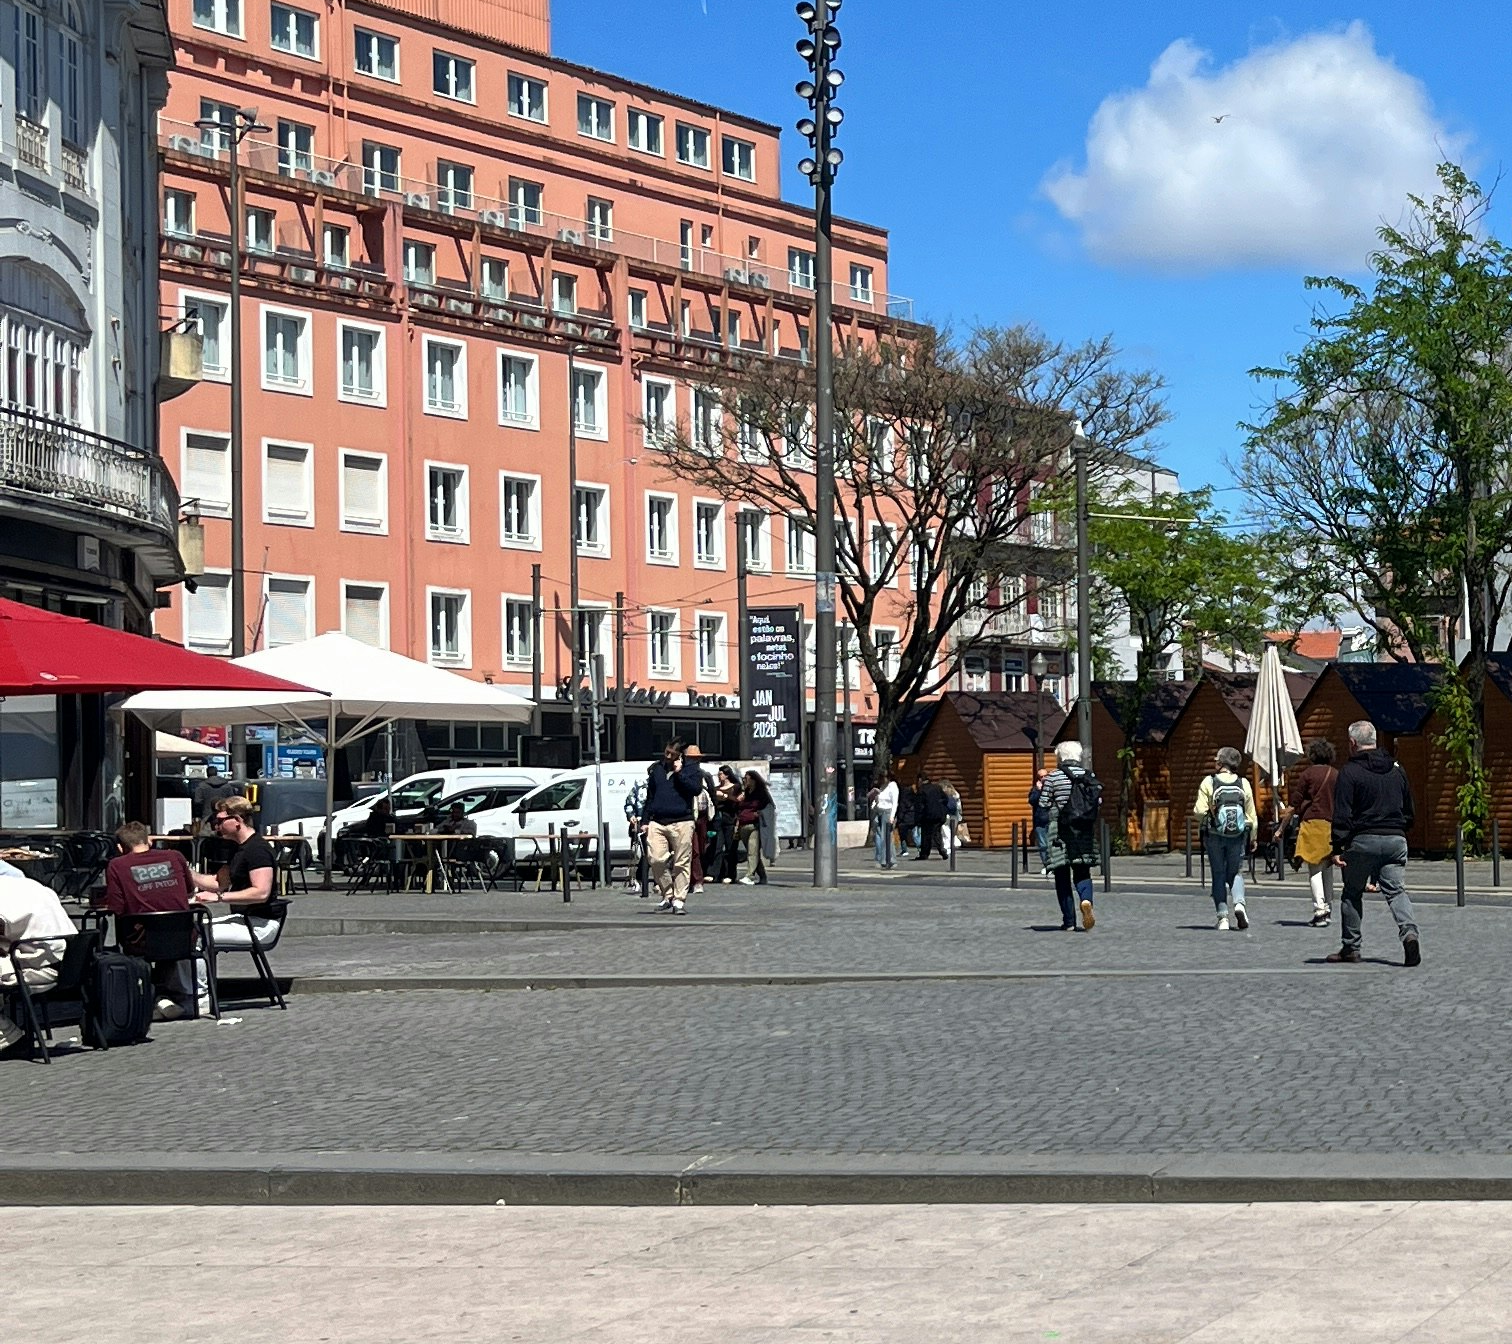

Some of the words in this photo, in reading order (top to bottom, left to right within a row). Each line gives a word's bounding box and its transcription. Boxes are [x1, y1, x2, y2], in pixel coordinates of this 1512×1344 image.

[750, 634, 795, 645] palavras,
[757, 652, 795, 661] focinho
[752, 689, 773, 707] JAN
[753, 721, 777, 738] 2026
[137, 864, 170, 881] 223
